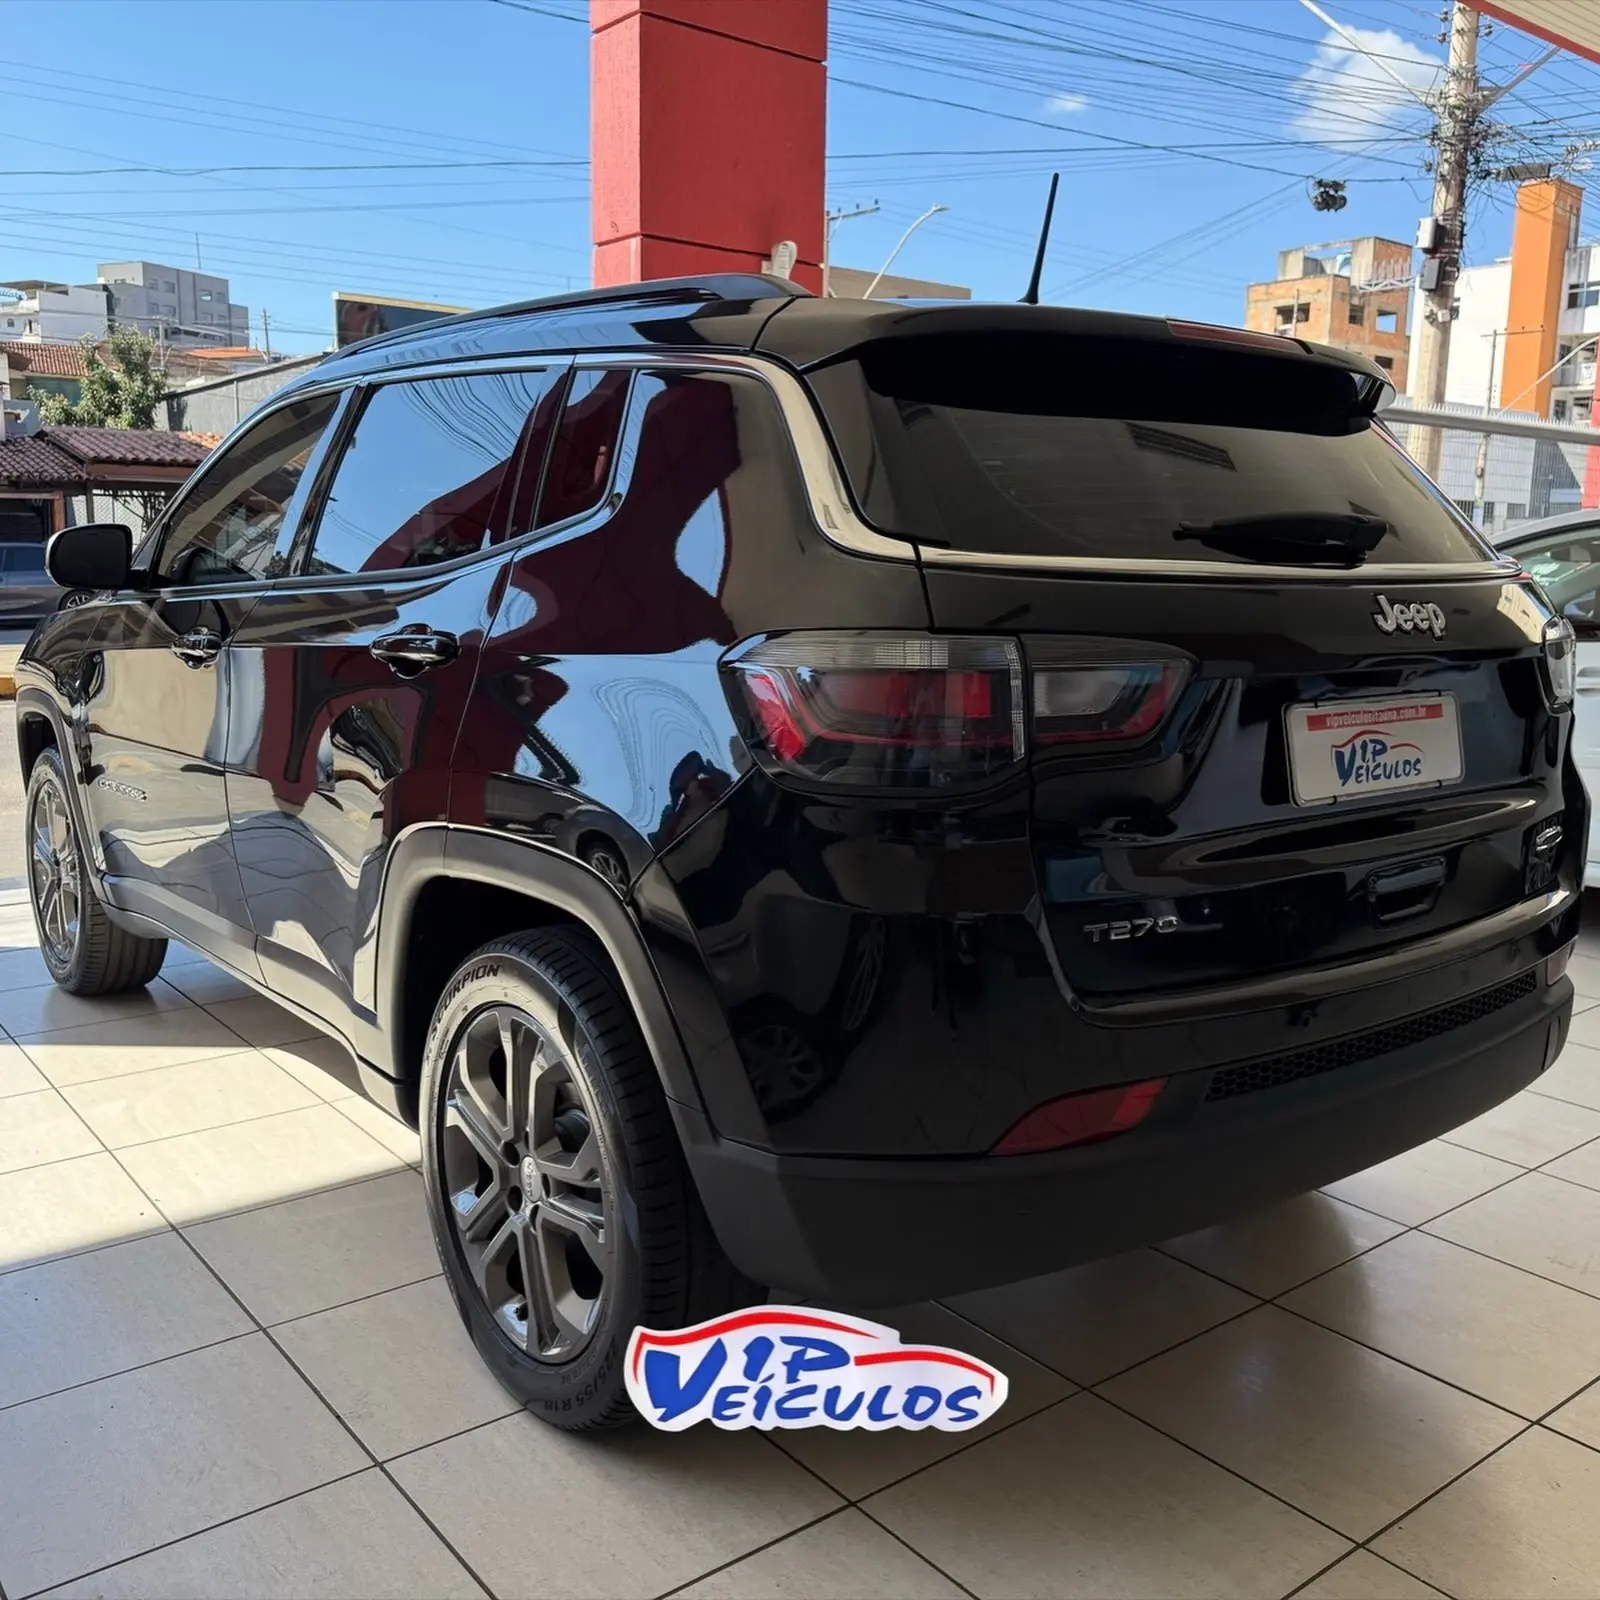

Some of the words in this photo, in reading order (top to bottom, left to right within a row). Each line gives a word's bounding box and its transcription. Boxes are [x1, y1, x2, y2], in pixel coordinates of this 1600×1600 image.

[1372, 594, 1447, 638] Jeep
[1335, 739, 1388, 776] VIP
[1083, 916, 1177, 943] T270
